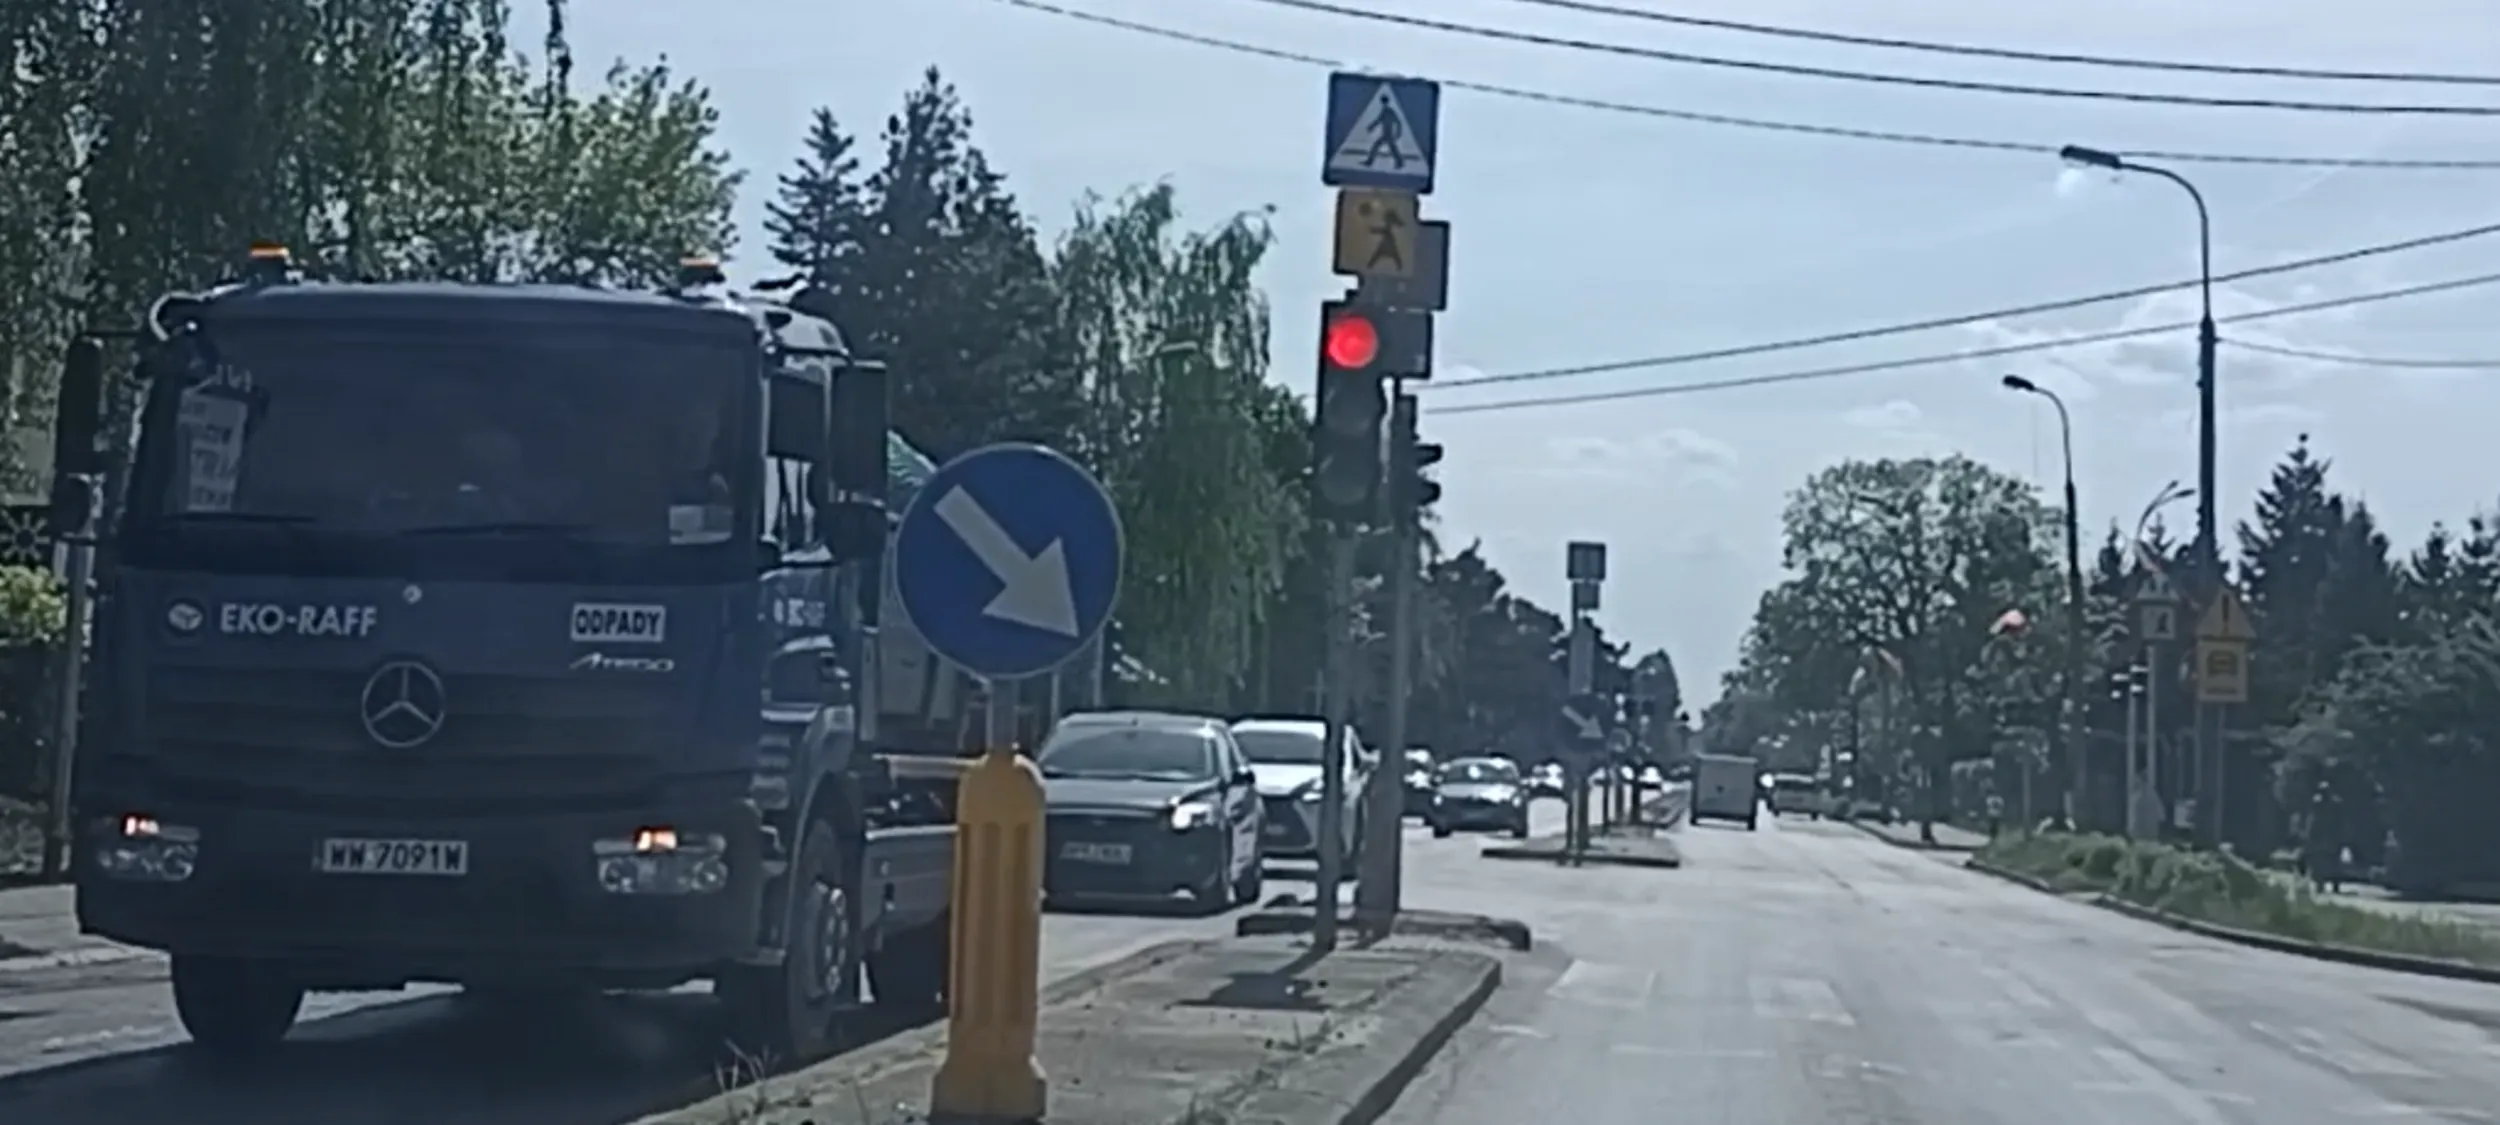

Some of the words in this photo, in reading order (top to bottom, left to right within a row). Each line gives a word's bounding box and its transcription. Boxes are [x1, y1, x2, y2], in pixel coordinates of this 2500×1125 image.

[220, 602, 378, 637] EKO-RAFF
[575, 608, 662, 636] ODPADY
[376, 842, 463, 871] 7091W
